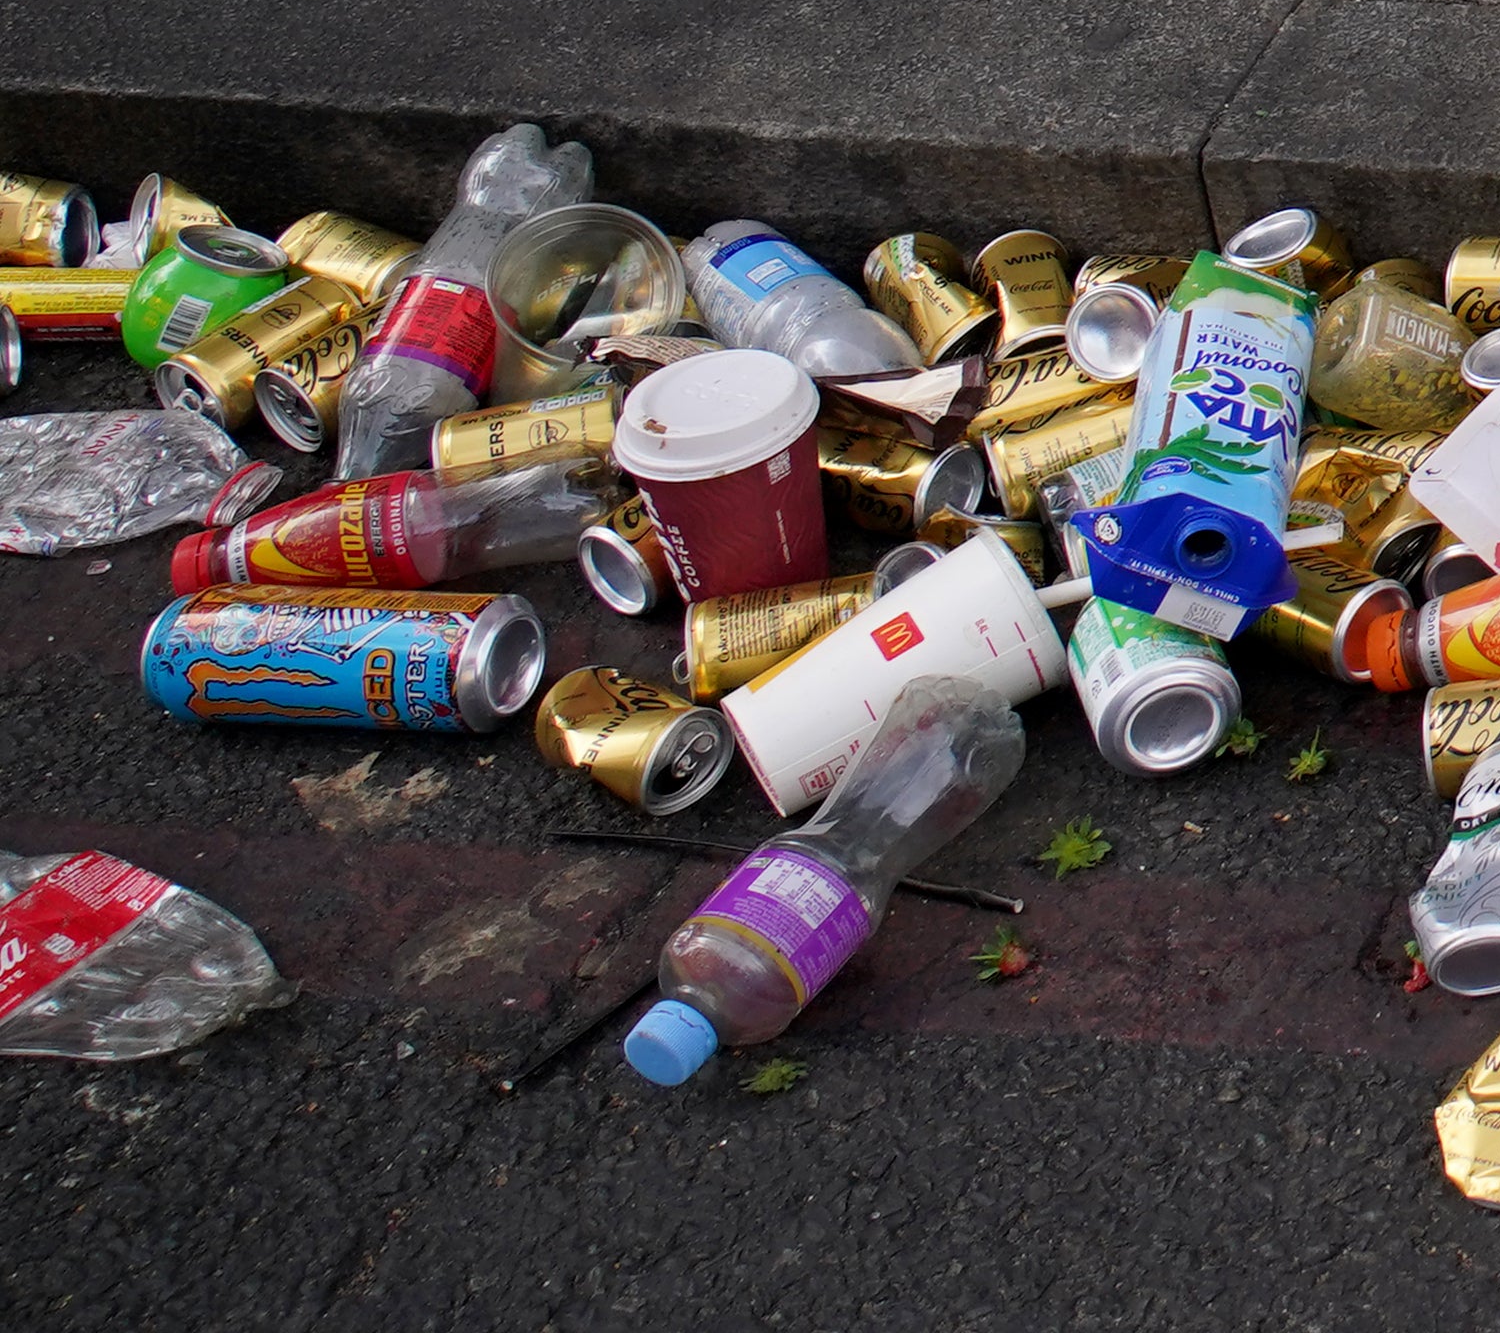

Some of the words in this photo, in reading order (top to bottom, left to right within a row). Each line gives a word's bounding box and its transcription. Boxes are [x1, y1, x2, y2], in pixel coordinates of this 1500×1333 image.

[1197, 333, 1259, 356] WATER
[1192, 350, 1300, 394] Coconut
[339, 481, 379, 589] Lucozade
[370, 498, 386, 558] ENERGY
[388, 491, 407, 556] ORIGINAL
[667, 524, 700, 588] COFFEE
[1216, 585, 1240, 604] CHILL
[1462, 814, 1489, 829] DRY
